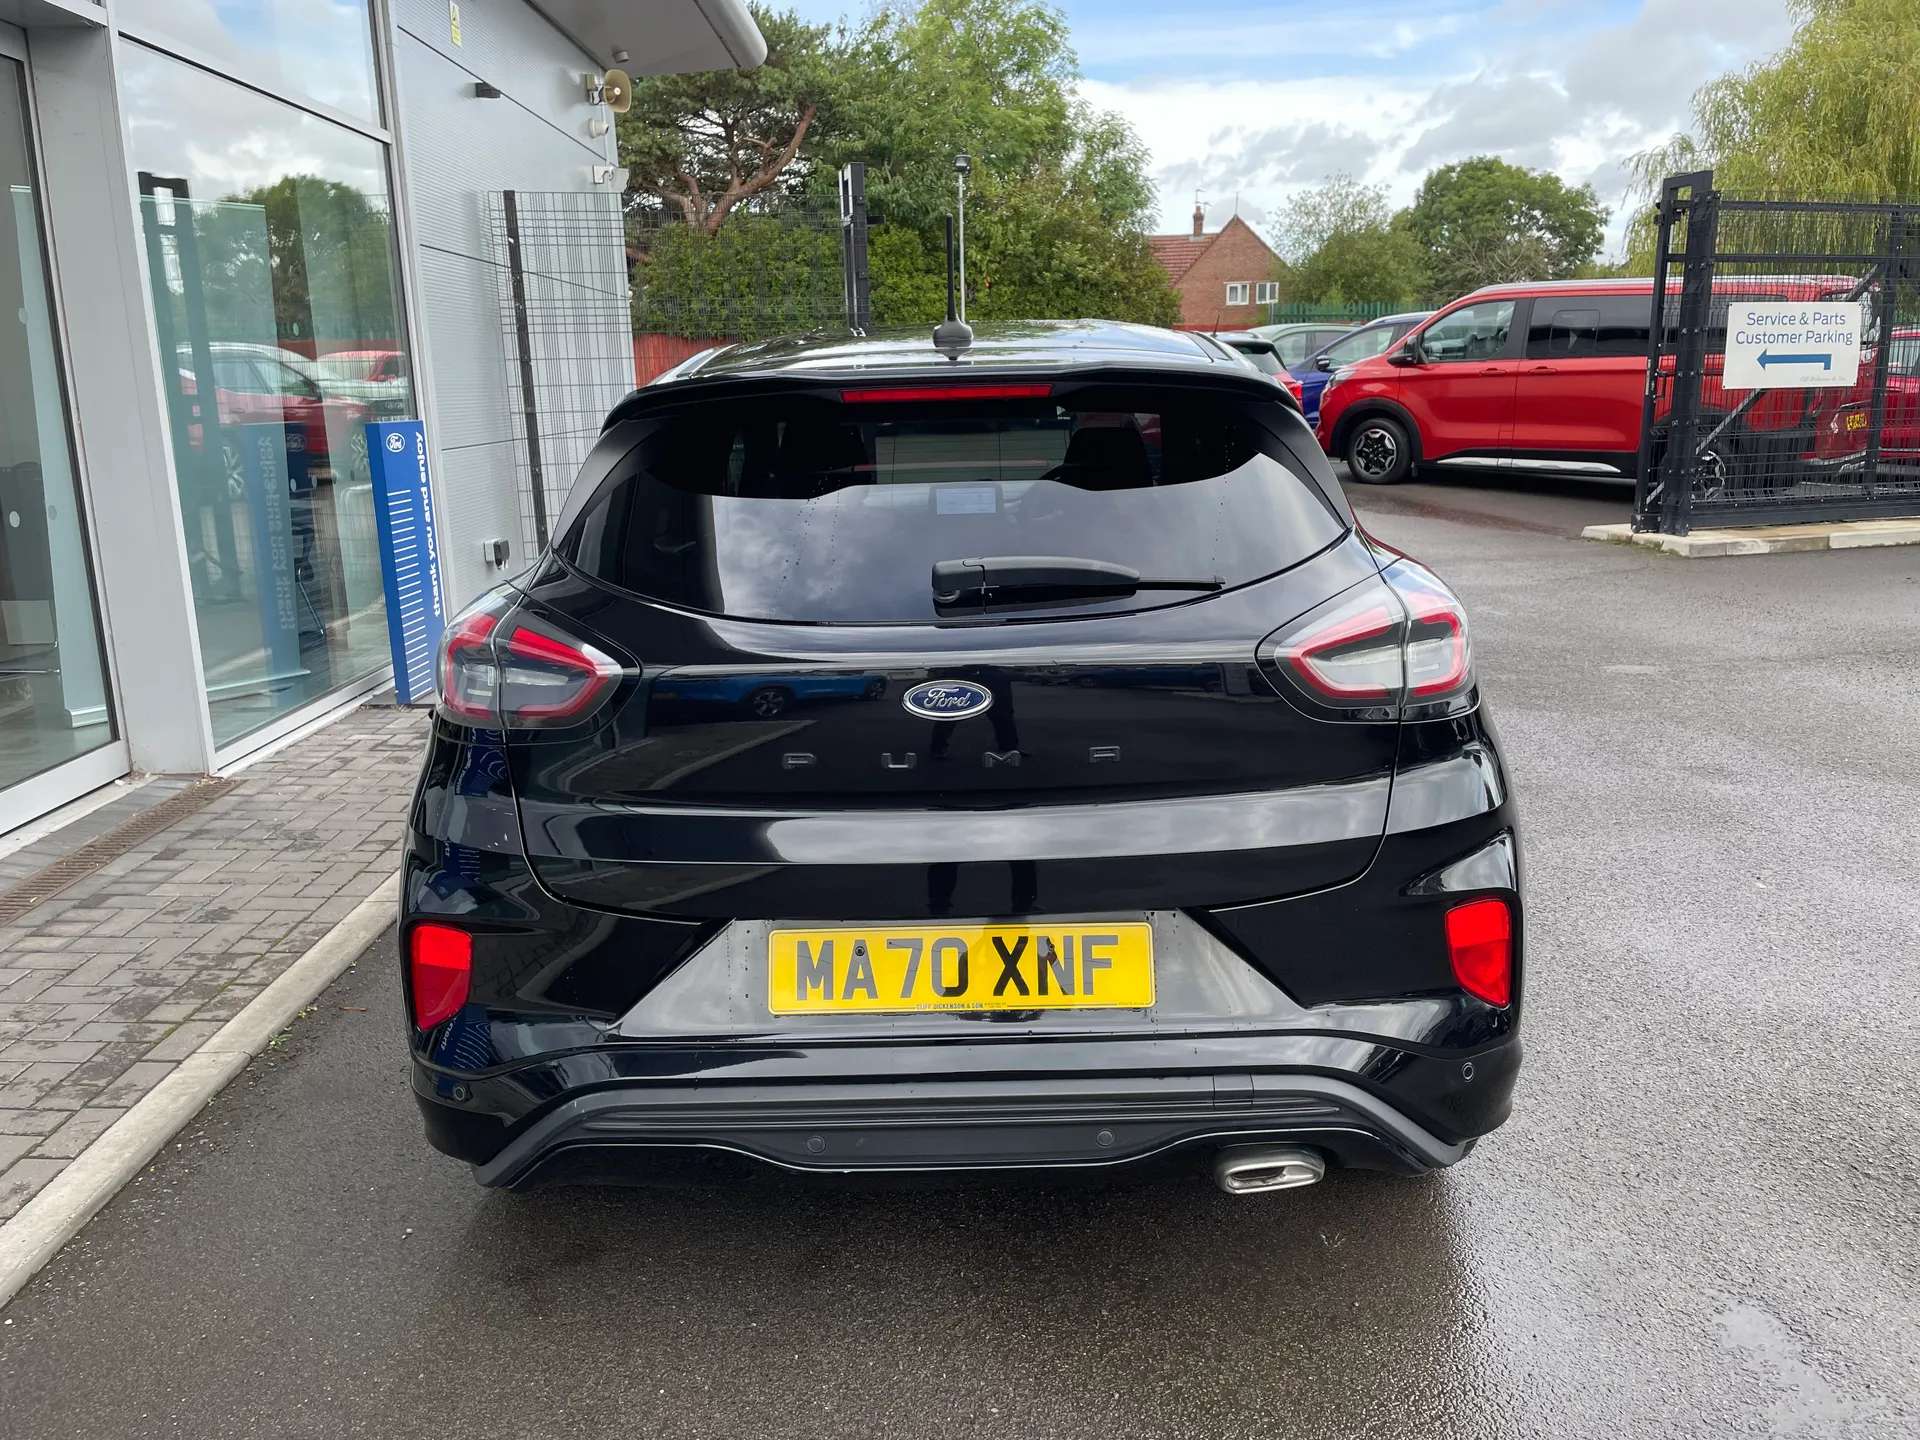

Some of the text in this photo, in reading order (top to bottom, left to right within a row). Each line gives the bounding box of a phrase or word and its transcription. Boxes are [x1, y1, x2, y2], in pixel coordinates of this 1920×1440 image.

[1746, 311, 1846, 326] Service & Parts
[1735, 330, 1853, 346] Customer Parking
[416, 432, 441, 617] thank you and enjoy
[923, 687, 972, 708] Ford
[782, 746, 1121, 769] PUMA
[796, 935, 1119, 1001] MA70 XNF
